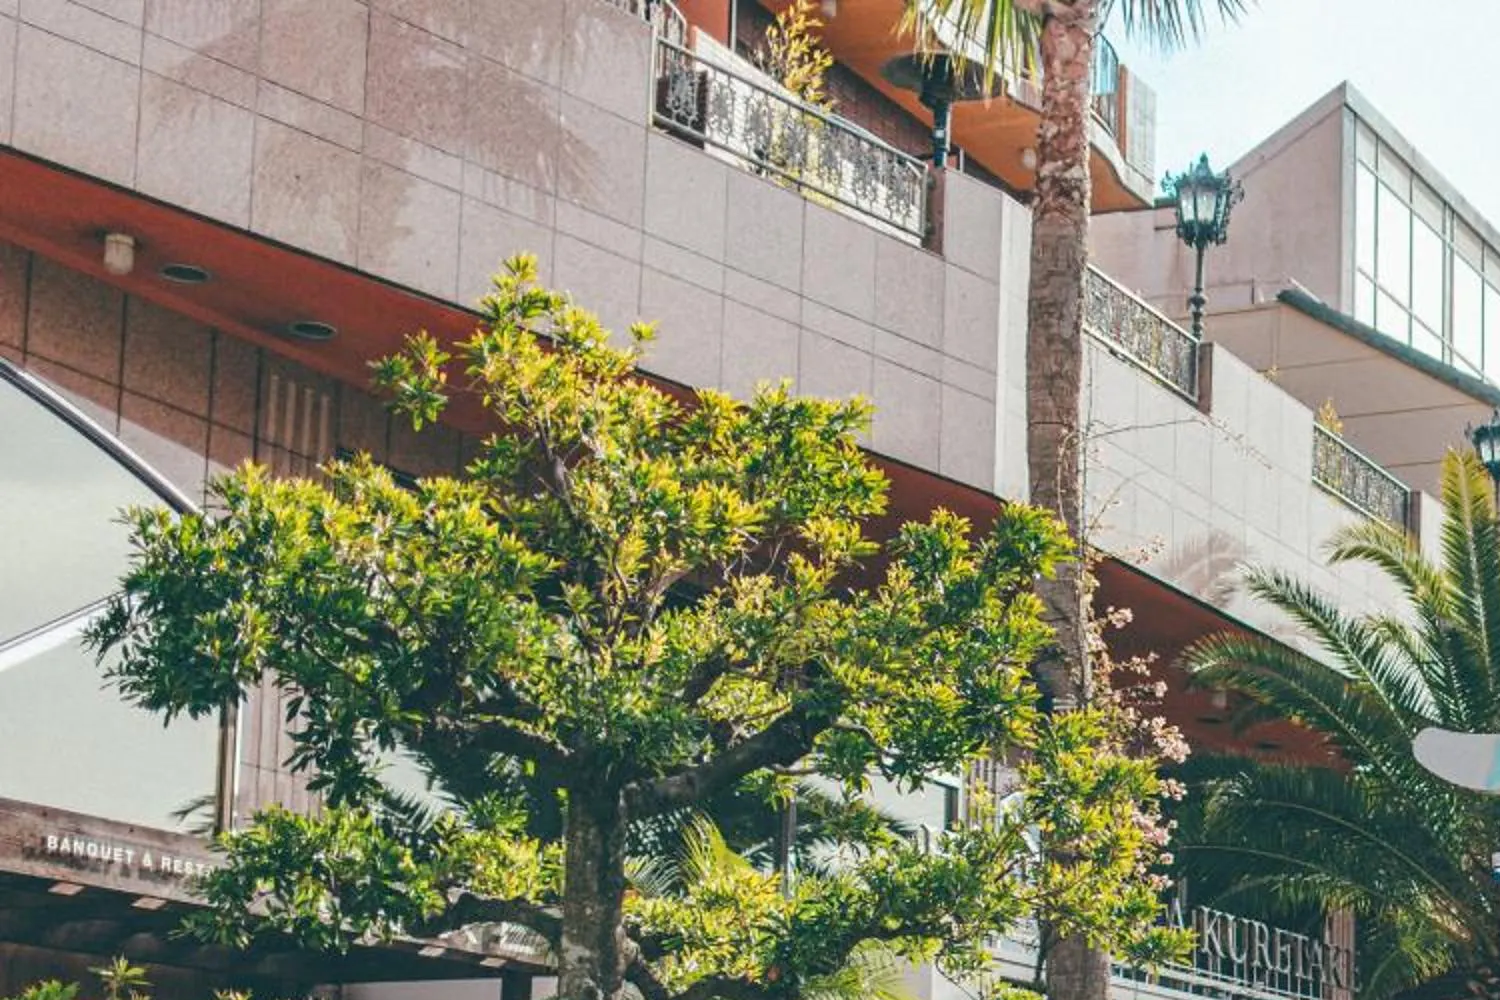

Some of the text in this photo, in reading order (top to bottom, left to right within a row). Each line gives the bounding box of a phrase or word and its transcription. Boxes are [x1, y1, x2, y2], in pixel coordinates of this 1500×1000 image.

[46, 834, 134, 866] BANQUET
[141, 852, 153, 867] &
[1199, 904, 1363, 992] KURETAKE
